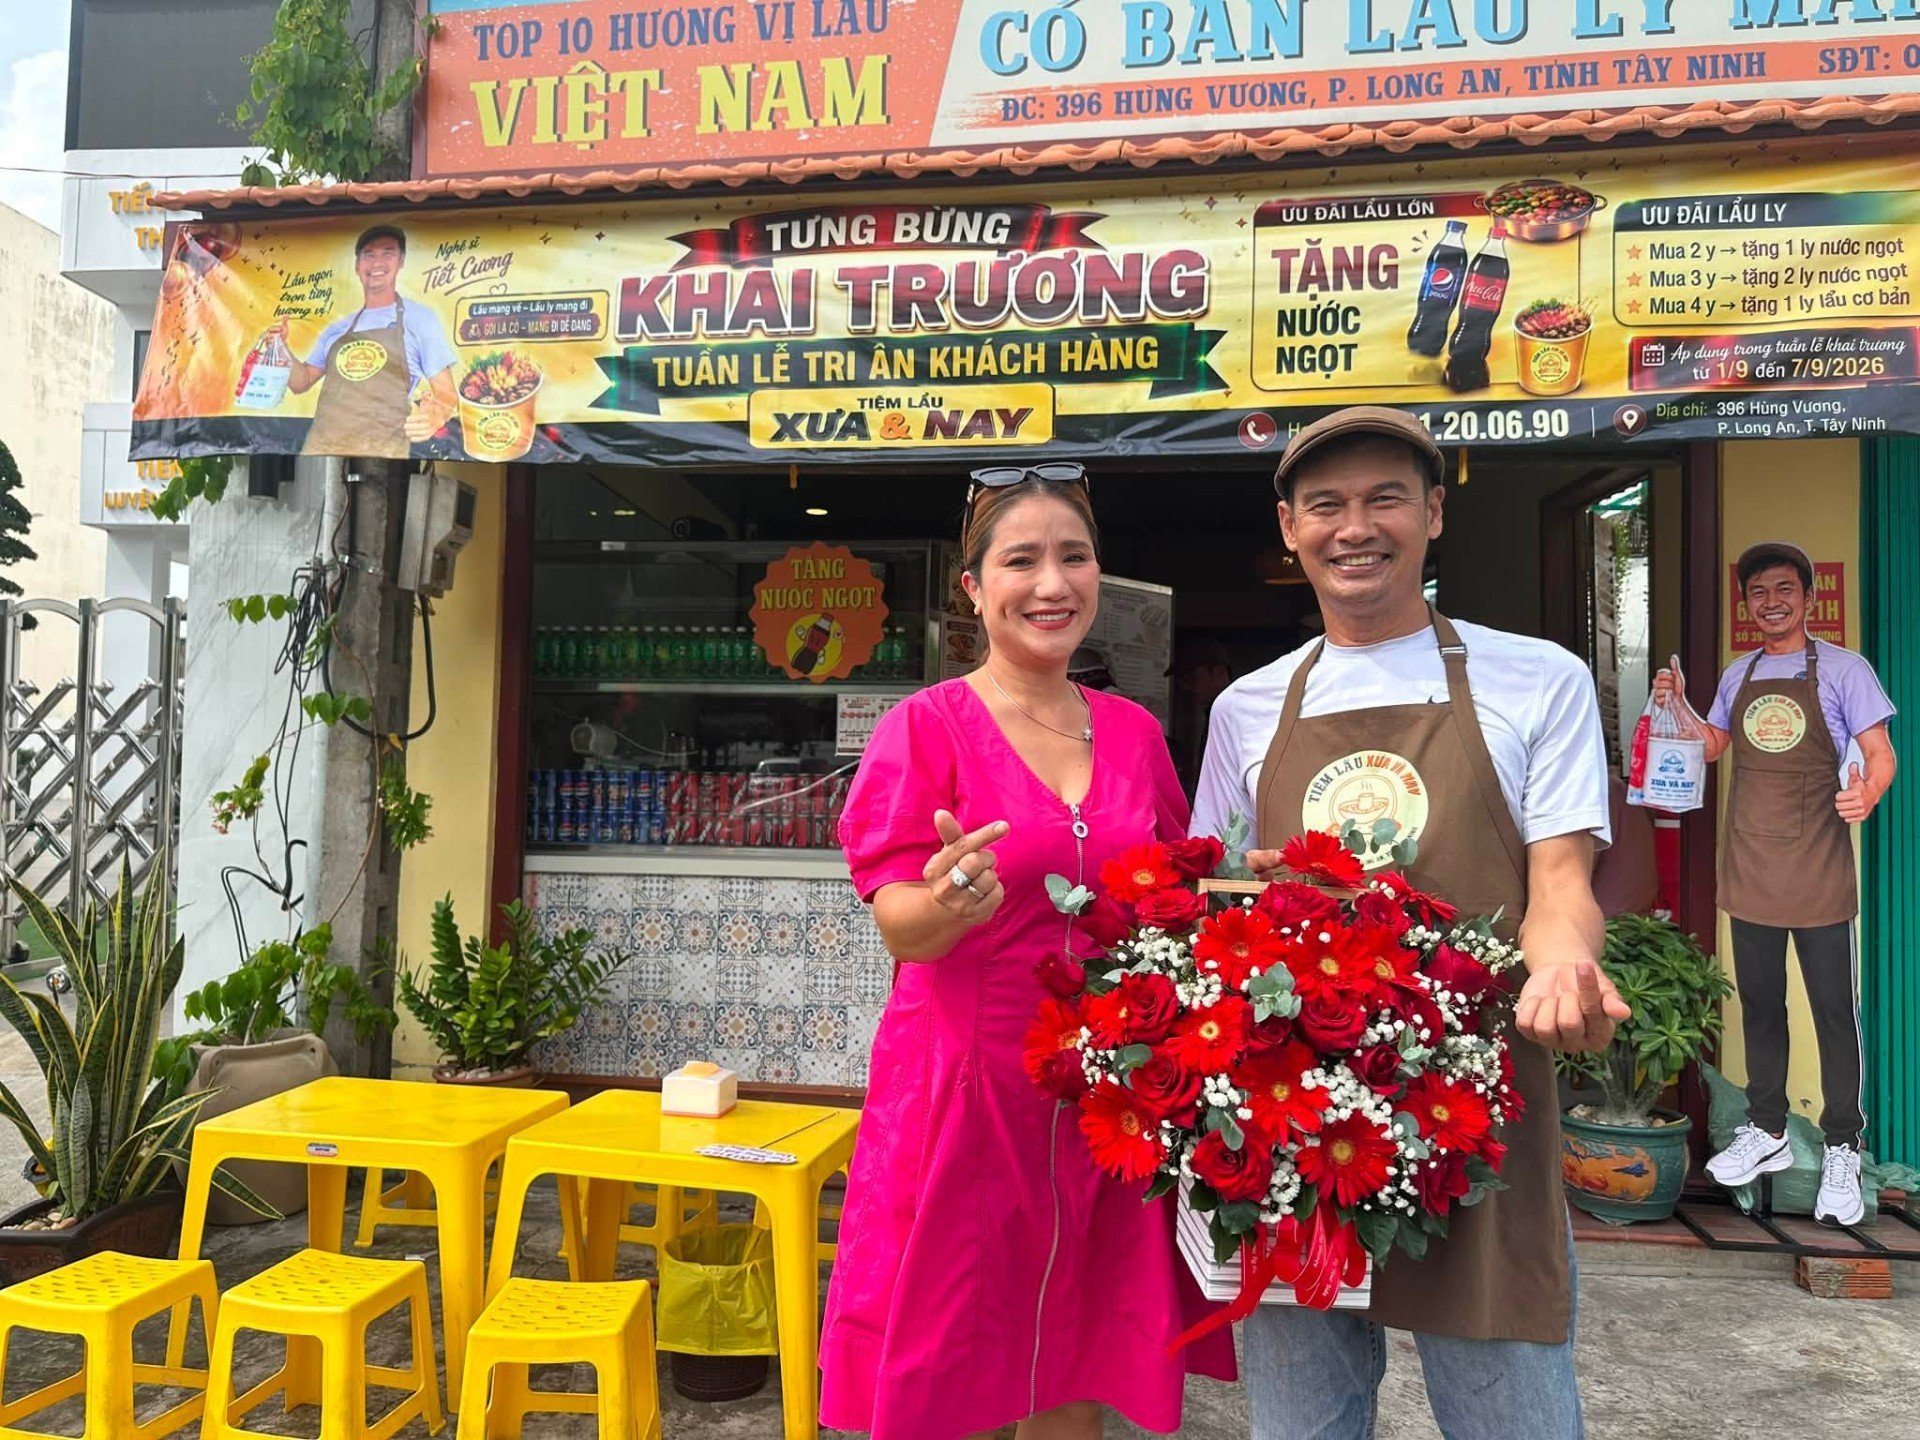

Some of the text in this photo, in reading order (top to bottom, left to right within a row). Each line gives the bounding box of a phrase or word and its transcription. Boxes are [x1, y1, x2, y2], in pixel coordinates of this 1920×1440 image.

[474, 20, 542, 61] TOP
[559, 17, 593, 55] 10
[609, 6, 737, 51] HƯƠNG
[753, 2, 796, 44] VỊ
[1818, 44, 1891, 75] SĐT:
[1002, 96, 1044, 122] ĐC:
[1055, 92, 1102, 118] 396
[1114, 83, 1193, 115] HÙNG
[1327, 77, 1355, 103] P.
[1366, 71, 1444, 100] LONG
[1457, 67, 1512, 97] AN,
[1612, 53, 1673, 84] TÂY
[1686, 51, 1767, 80] NINH
[470, 54, 892, 151] VIỆT NAM
[1281, 196, 1435, 223] ƯU ĐÃI LẨU LỚN
[1641, 196, 1788, 226] ƯU ĐÃI LẨU LY
[765, 206, 1012, 250] TƯNG BỪNG
[1650, 238, 1904, 262] Mua 2 y tặng 1 ly nước ngọt
[1271, 238, 1399, 301] TẶNG
[1650, 262, 1908, 289] Mua 3 y tặng 2 ly nước ngọt
[555, 302, 578, 313] mang
[615, 247, 1210, 342] KHAI TRƯƠNG
[1650, 286, 1911, 317] Mua 4 y tặng 1 ly lẩu cơ bản
[1276, 300, 1362, 338] NƯỚC
[652, 335, 1159, 387] TUẦN LỄ TRI ÂN KHÁCH HÀNG
[1276, 343, 1359, 380] NGỌT
[1670, 341, 1691, 365] Áp
[1694, 344, 1731, 362] dụng
[1734, 342, 1772, 358] trong
[1826, 337, 1856, 353] khai
[1859, 337, 1907, 355] trương
[1717, 360, 1749, 379] 1/9
[1755, 360, 1785, 378] đến
[1791, 356, 1886, 378] 7/9/2026
[857, 393, 943, 412] TIỆM LẨU
[1656, 402, 1683, 419] Địa
[1717, 402, 1745, 416] 396
[1749, 401, 1788, 417] Hùng
[1792, 399, 1846, 417] Vương,
[769, 407, 1035, 443] XƯA & NAY
[1717, 417, 1886, 437] P. Long An, T. Tây Ninh
